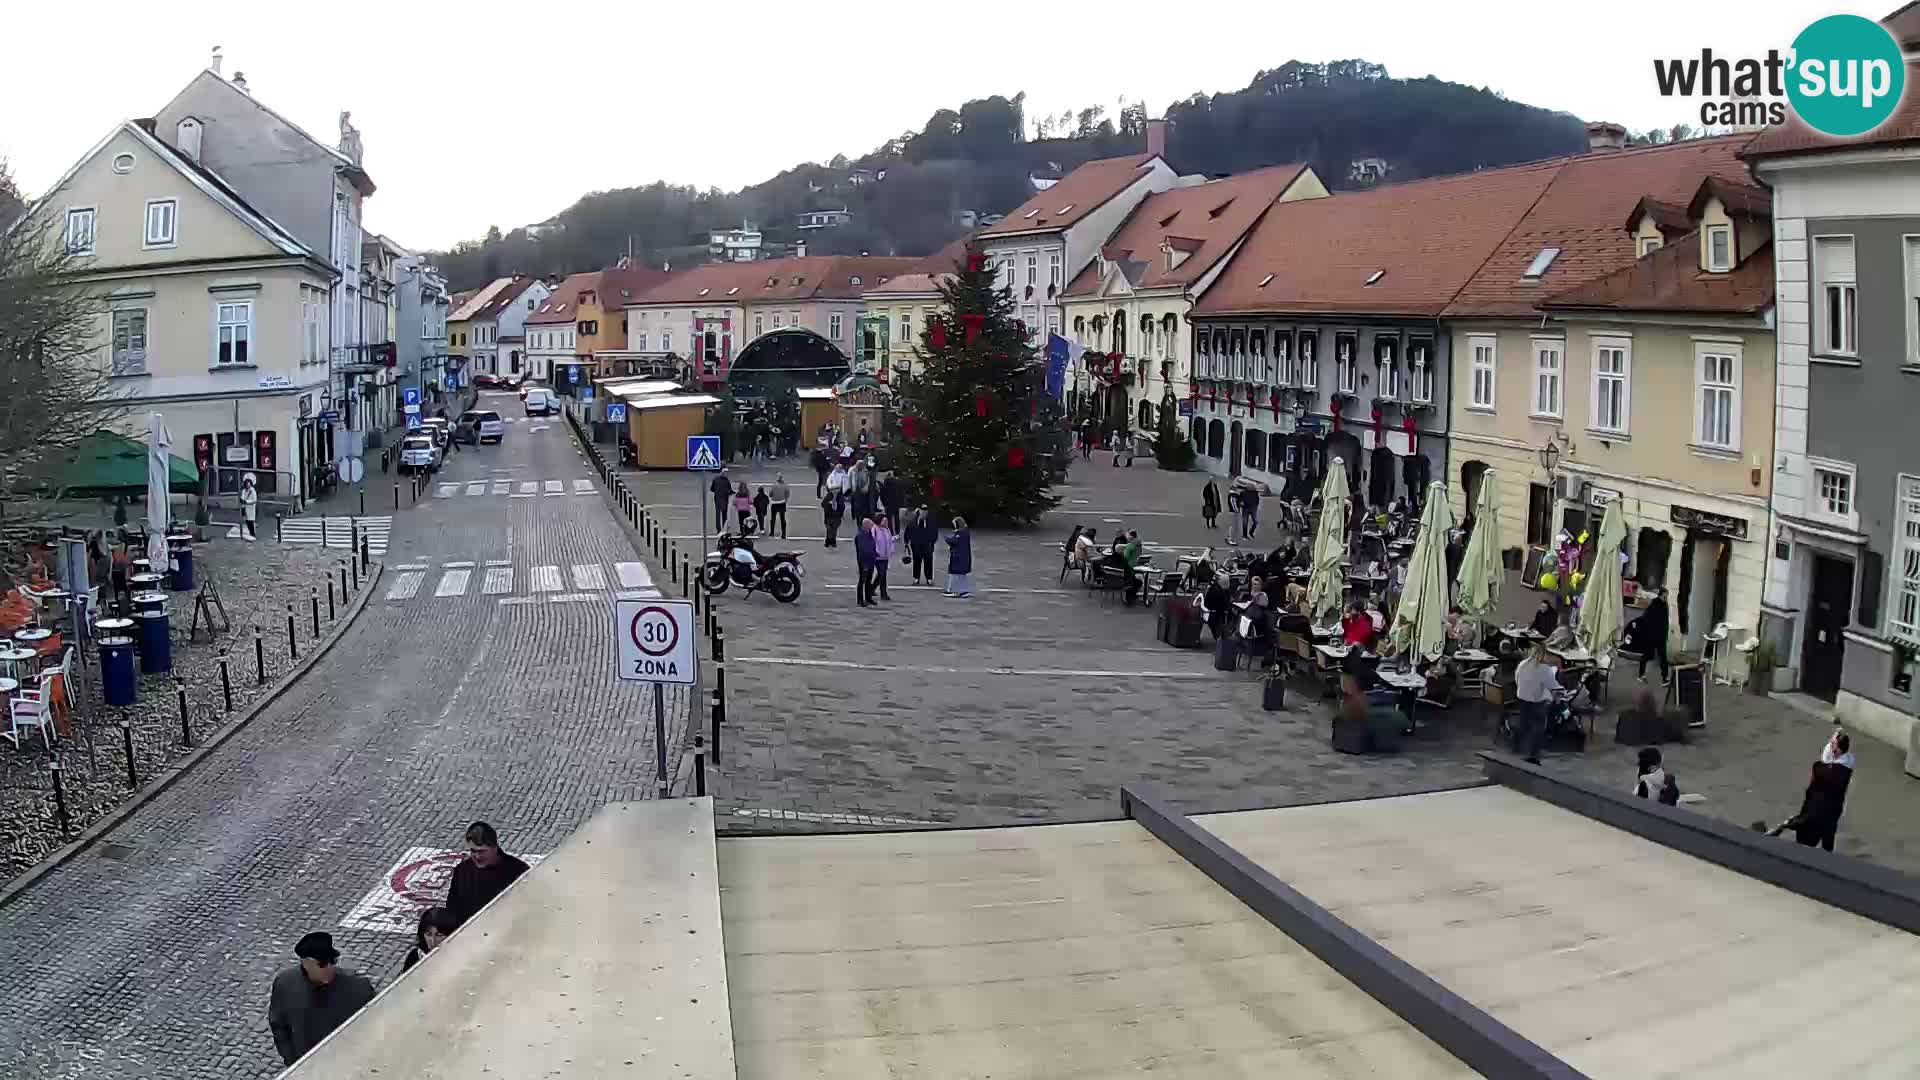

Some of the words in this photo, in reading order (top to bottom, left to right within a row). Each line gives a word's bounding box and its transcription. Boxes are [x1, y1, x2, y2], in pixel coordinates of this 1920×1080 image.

[408, 391, 416, 403] P
[643, 622, 667, 643] 30
[634, 659, 678, 676] ZONA
